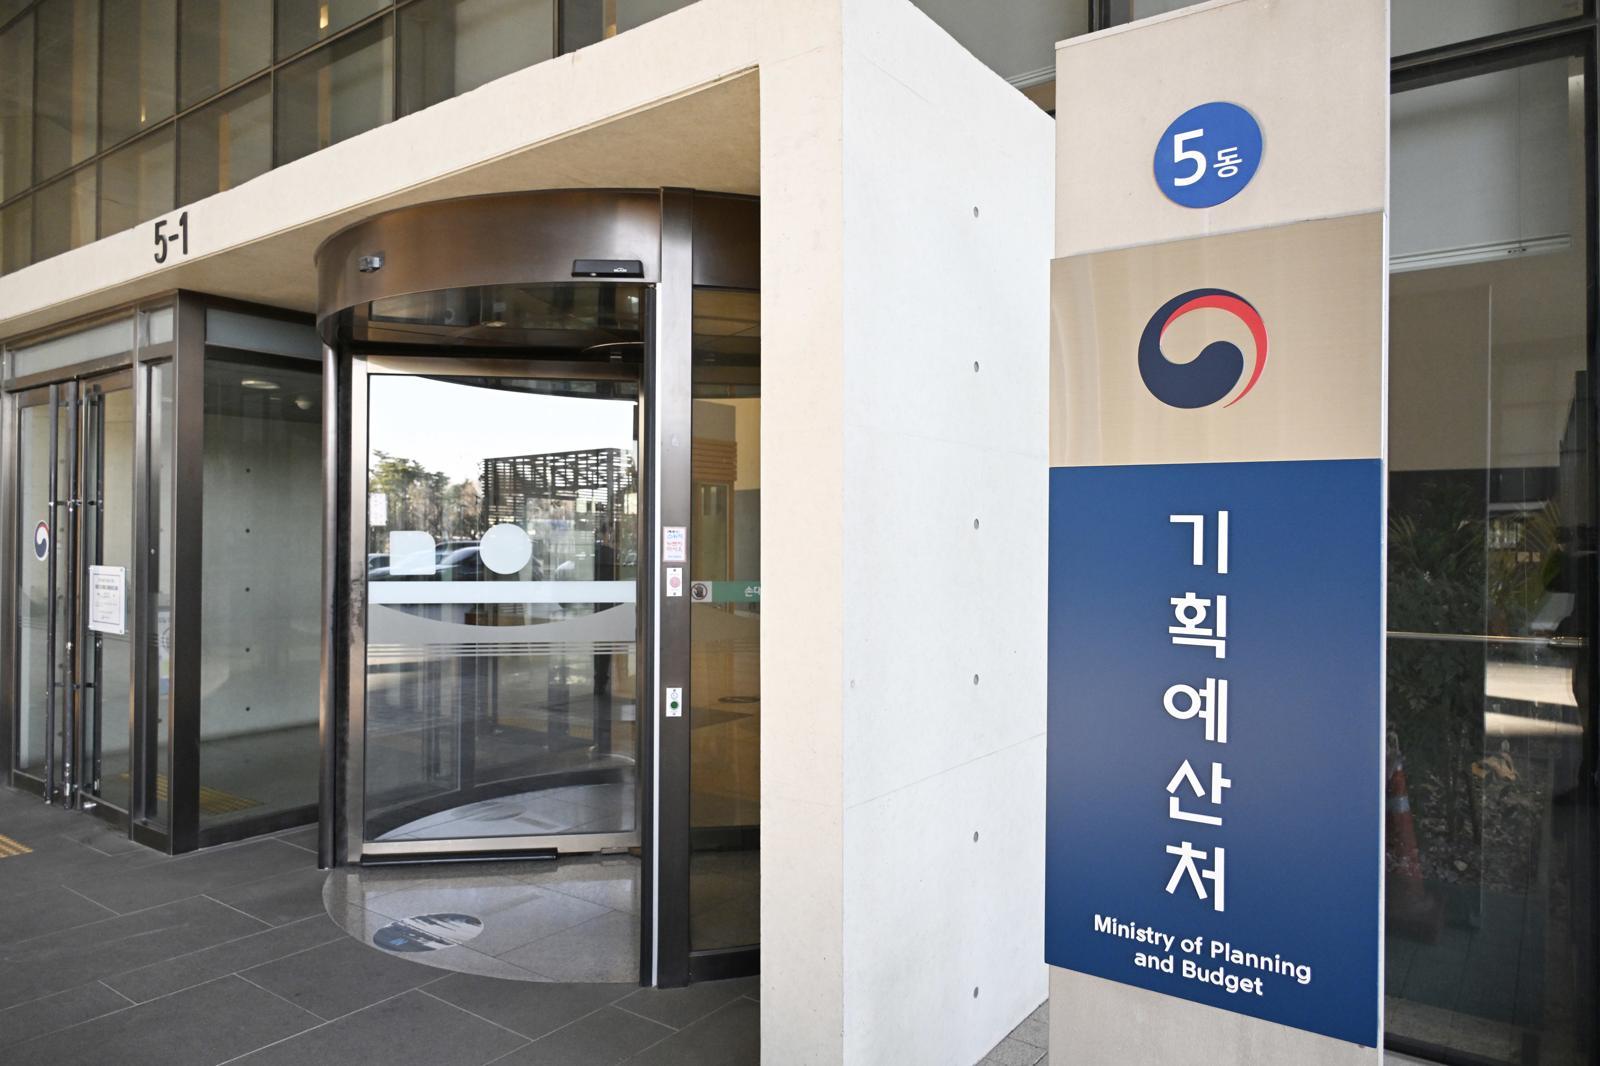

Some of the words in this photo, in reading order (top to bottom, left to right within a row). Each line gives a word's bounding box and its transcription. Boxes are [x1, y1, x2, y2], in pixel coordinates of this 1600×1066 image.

[154, 210, 189, 264] 5-1
[1163, 510, 1232, 913] 기획예산처
[1093, 913, 1175, 953] Ministry
[1180, 936, 1203, 956] of
[1210, 940, 1312, 985] Planning
[1134, 952, 1174, 974] and
[1182, 959, 1264, 997] Budget
